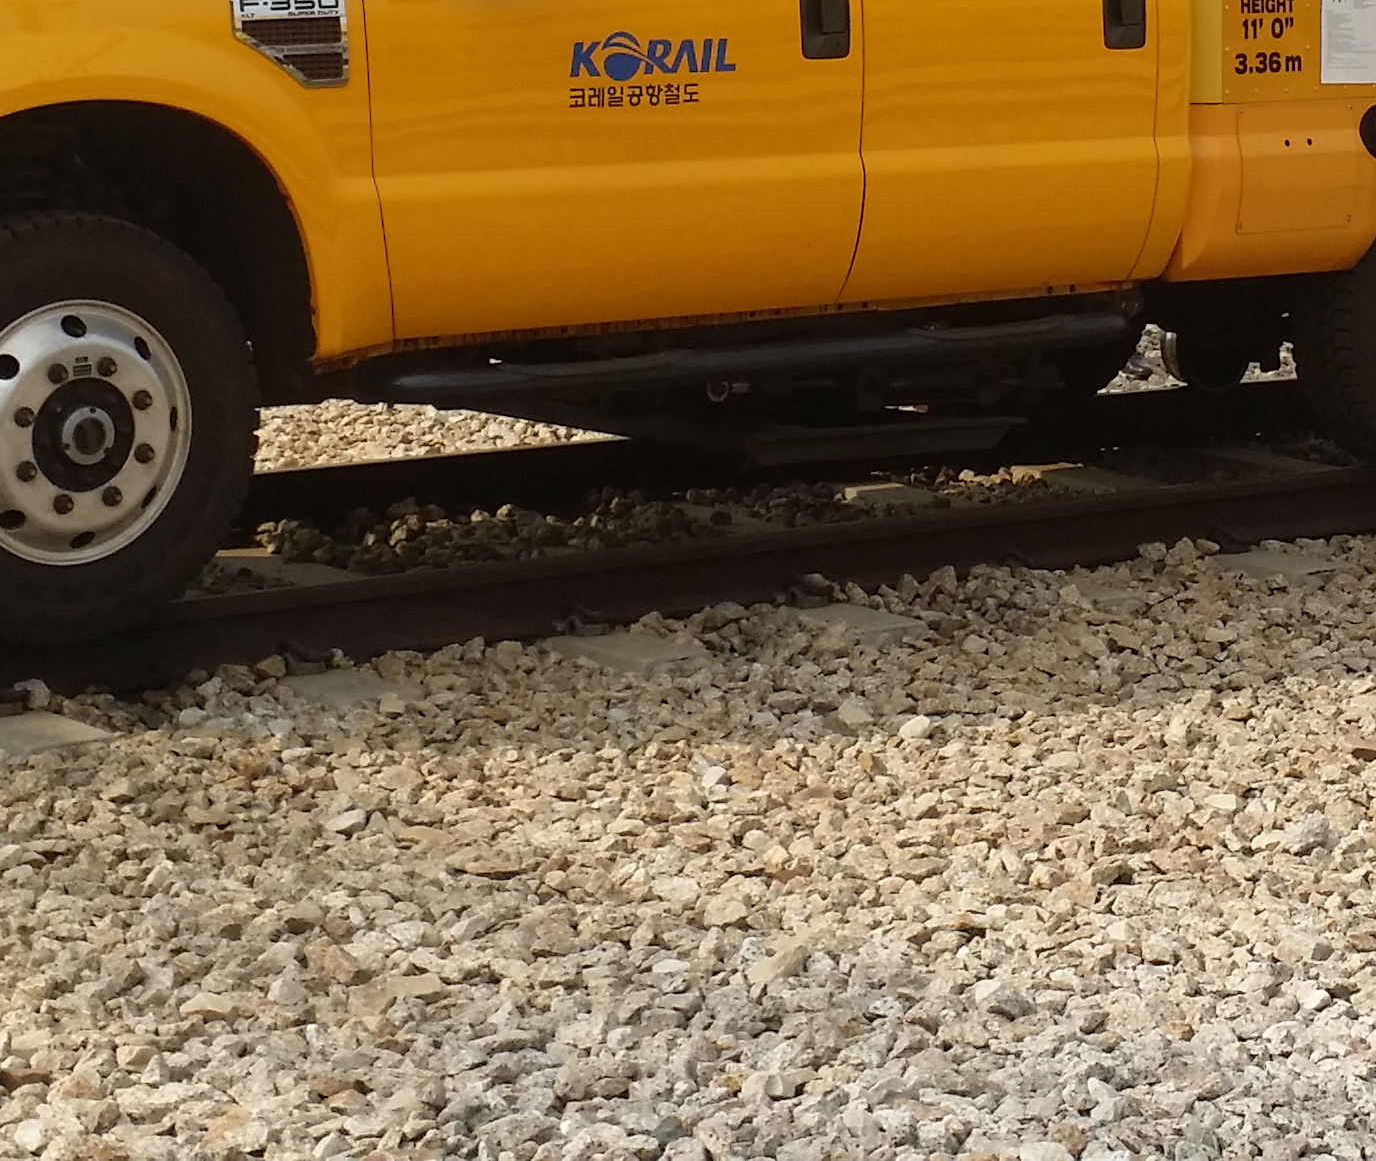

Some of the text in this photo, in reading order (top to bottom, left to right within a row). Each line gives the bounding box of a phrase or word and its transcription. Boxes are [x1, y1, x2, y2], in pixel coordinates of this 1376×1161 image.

[569, 31, 737, 82] KORAIL
[1234, 51, 1302, 75] 3.36 m
[569, 83, 700, 109] 코레일공항철도
